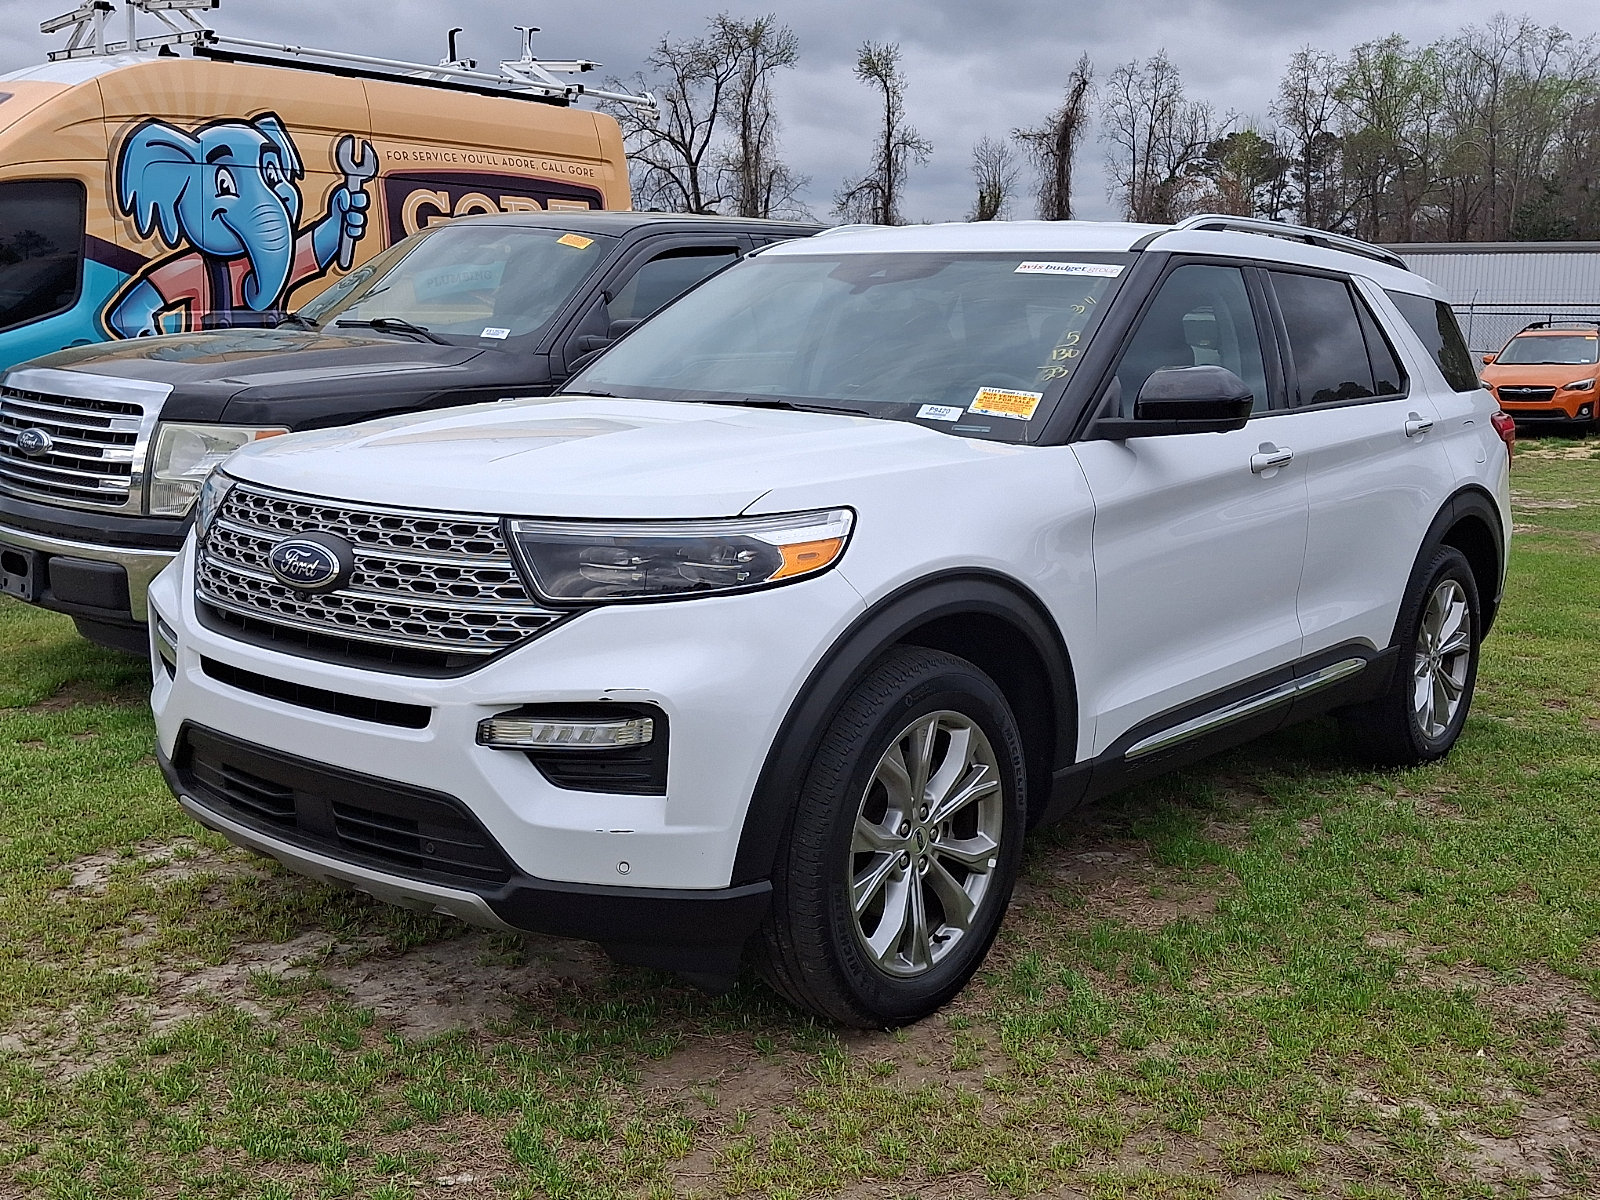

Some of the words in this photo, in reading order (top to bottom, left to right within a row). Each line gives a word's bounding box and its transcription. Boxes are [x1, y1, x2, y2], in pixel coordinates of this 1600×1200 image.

[386, 151, 409, 161] FOR
[412, 151, 458, 163] SERVICE
[460, 153, 499, 166] YOU'LL
[502, 158, 539, 171] ADORE,
[541, 162, 566, 174] CALL
[568, 165, 595, 178] GORE
[1045, 264, 1087, 273] budget
[20, 432, 38, 449] Ford
[281, 548, 320, 577] Ford
